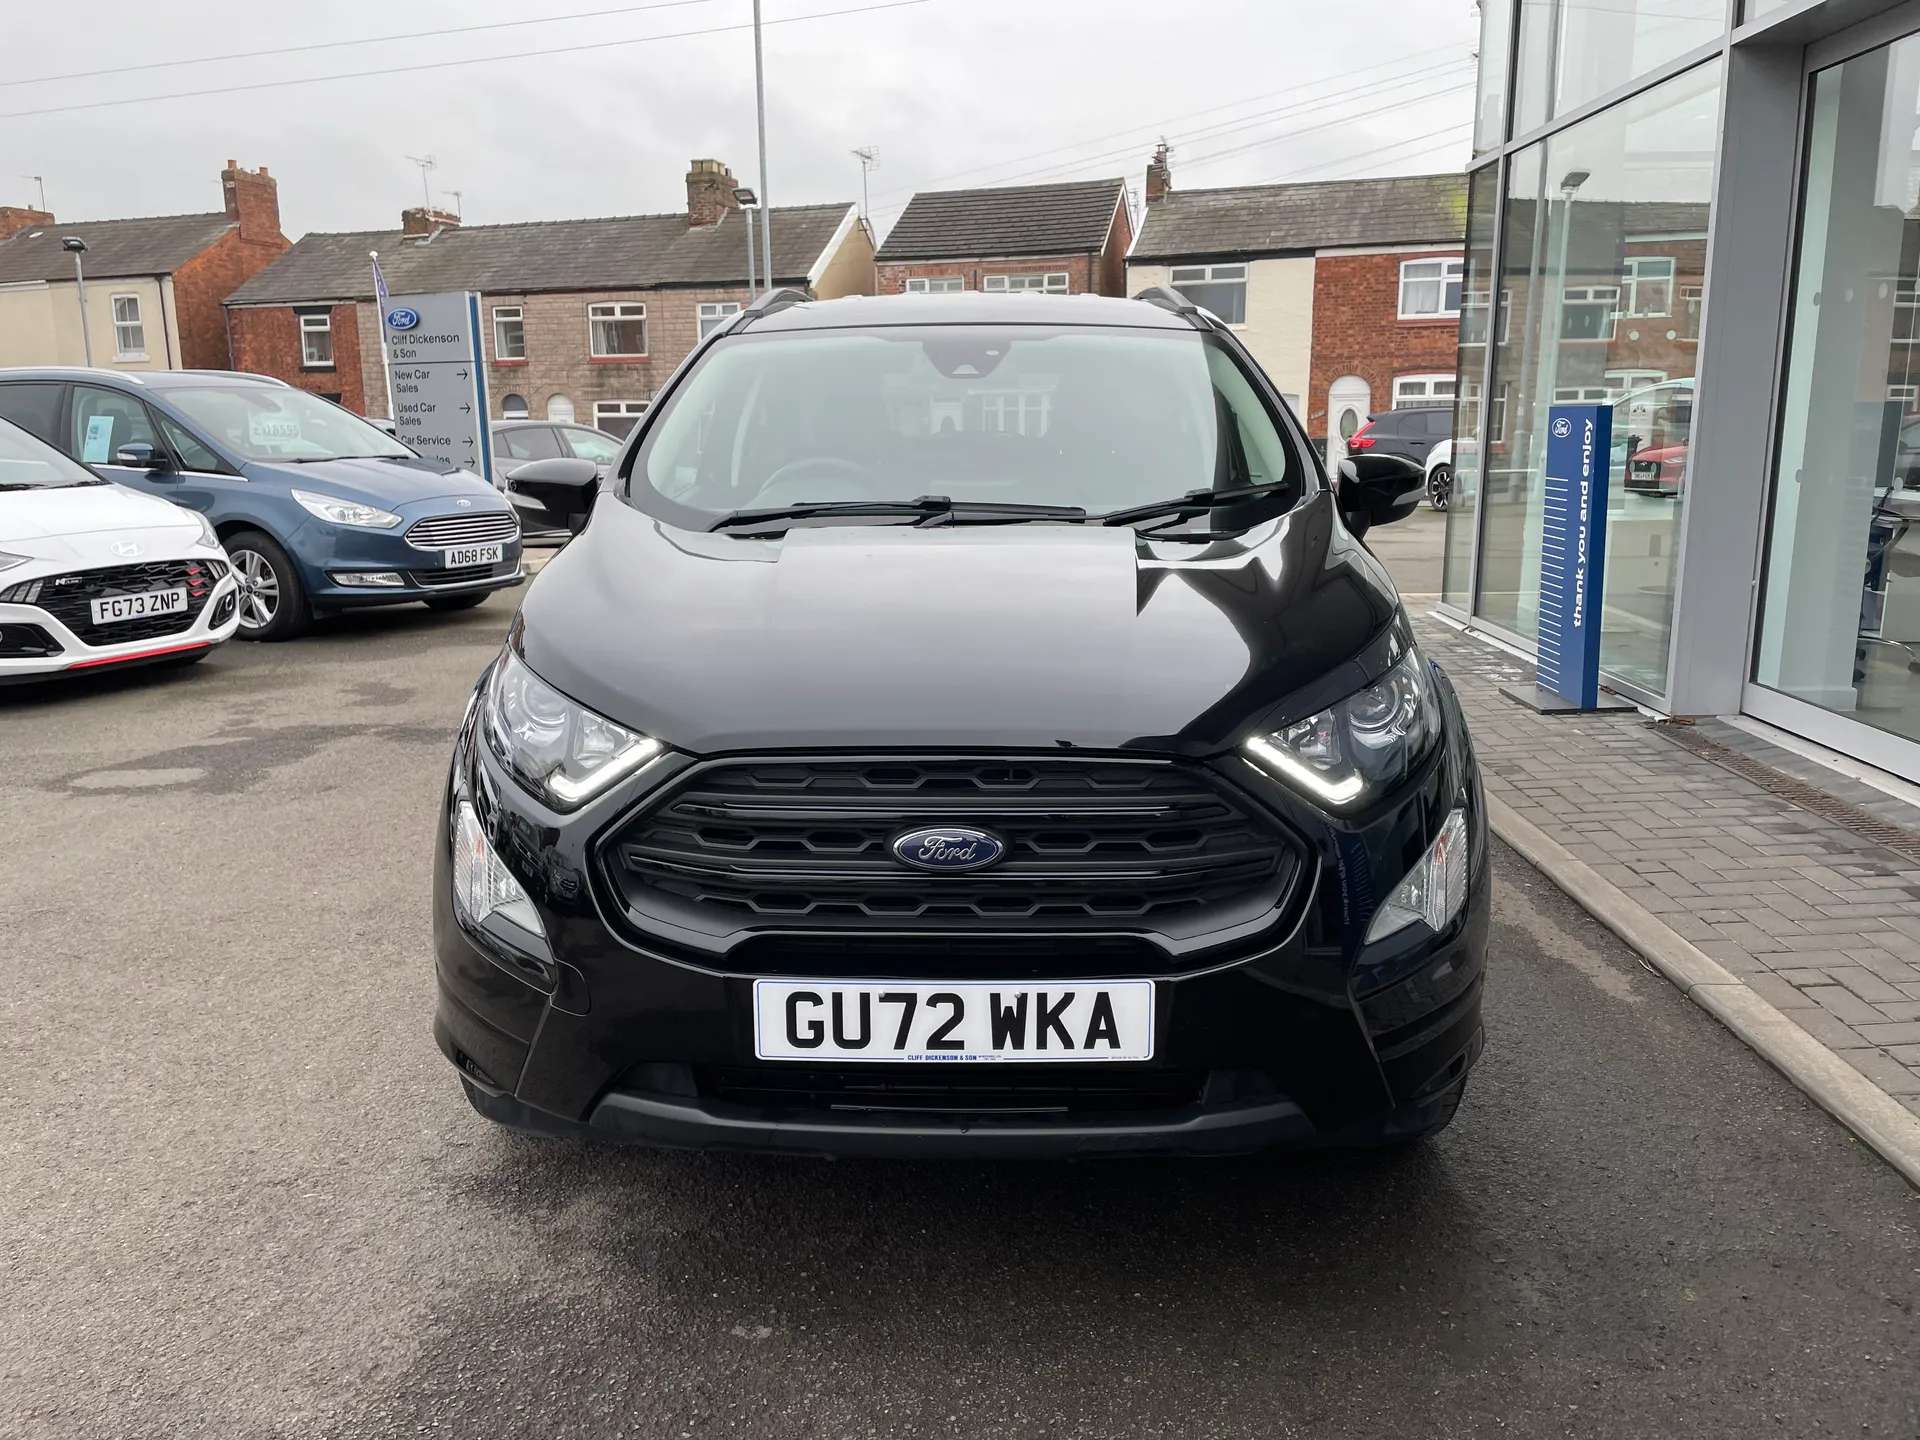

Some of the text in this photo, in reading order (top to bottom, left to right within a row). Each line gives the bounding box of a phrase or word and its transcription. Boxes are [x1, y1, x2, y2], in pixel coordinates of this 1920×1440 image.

[391, 333, 460, 345] Cliff Dickenson
[393, 348, 417, 359] & Son
[394, 369, 430, 380] New Car
[396, 383, 419, 393] Sales
[398, 402, 436, 413] Used Car
[399, 416, 422, 426] Sales
[416, 435, 451, 446] Service
[1573, 418, 1593, 627] thank you and enjoy
[451, 547, 499, 565] AD68 FSK
[100, 592, 180, 619] FG73 ZNP
[785, 991, 1121, 1051] GU72 WKA
